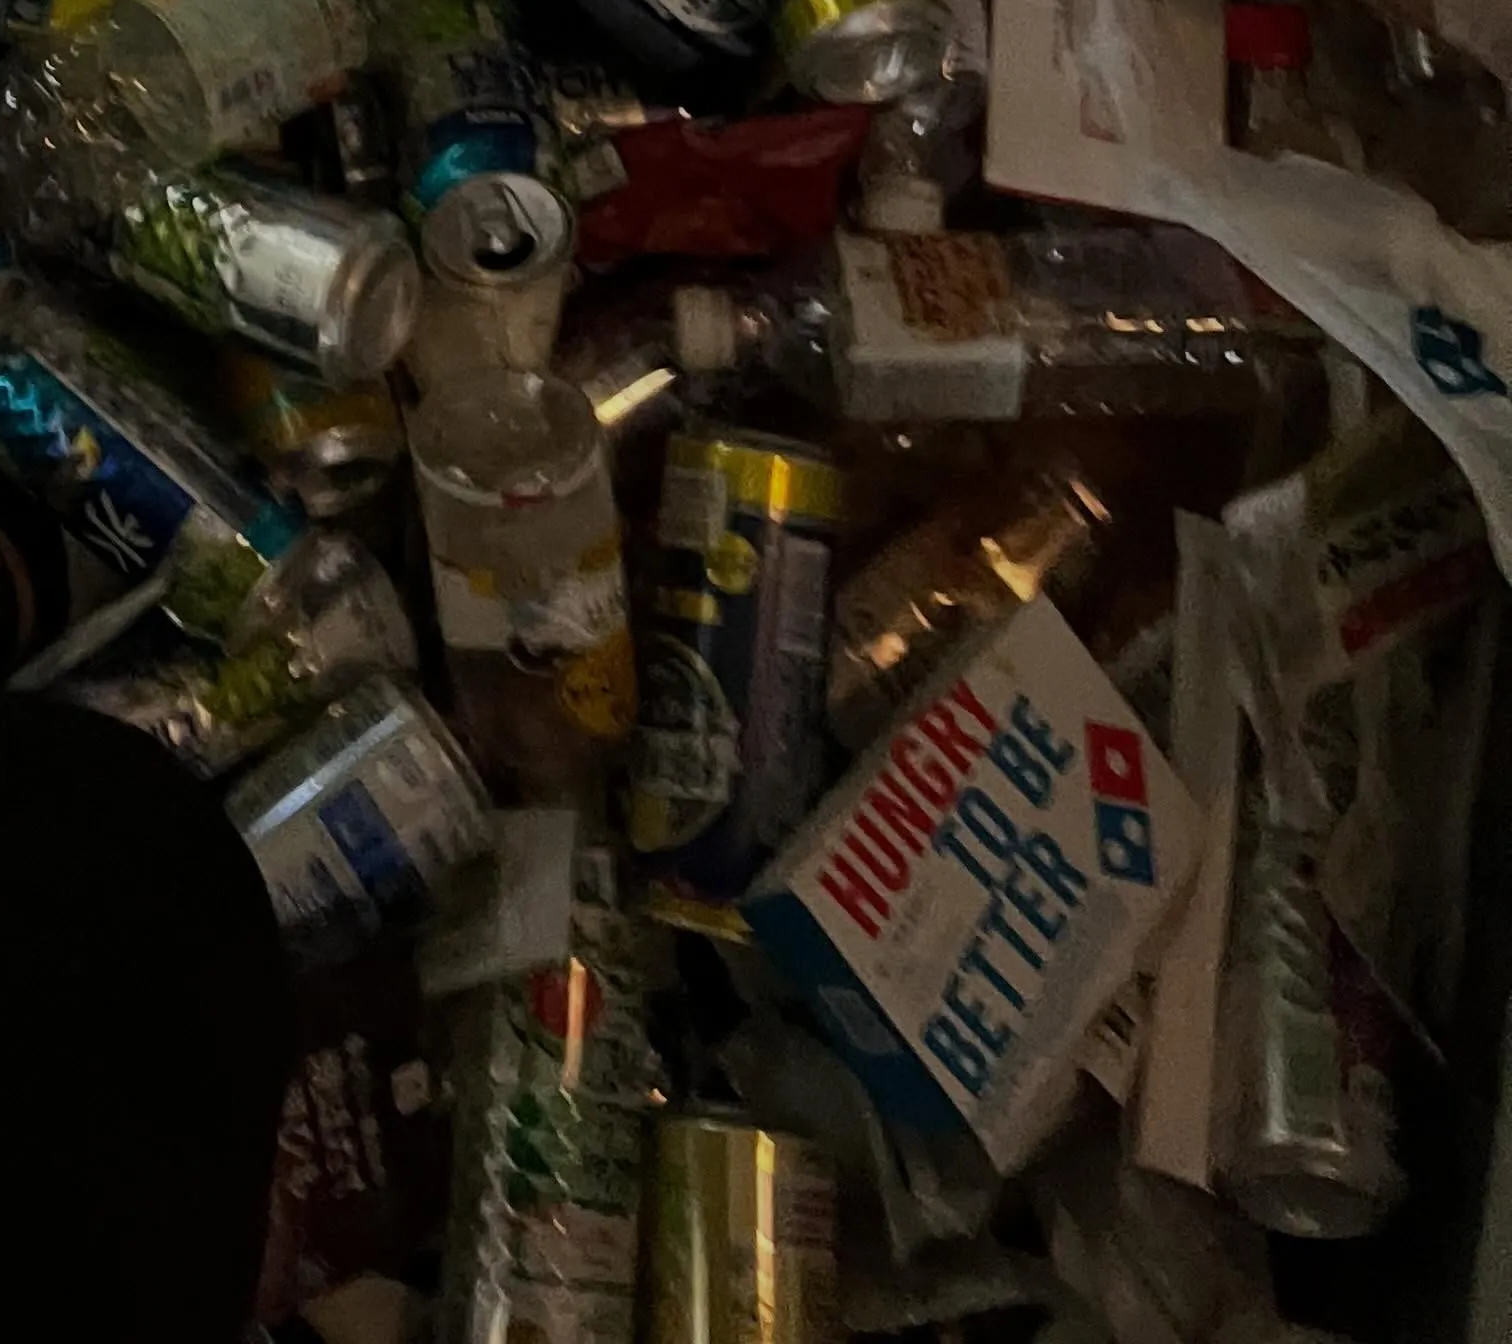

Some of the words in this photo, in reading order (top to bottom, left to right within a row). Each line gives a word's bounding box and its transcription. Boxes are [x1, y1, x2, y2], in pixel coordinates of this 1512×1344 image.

[817, 679, 1000, 940] HUNGRY
[931, 786, 1019, 902] TO
[989, 693, 1075, 810] BE
[923, 832, 1088, 1101] BETTER
